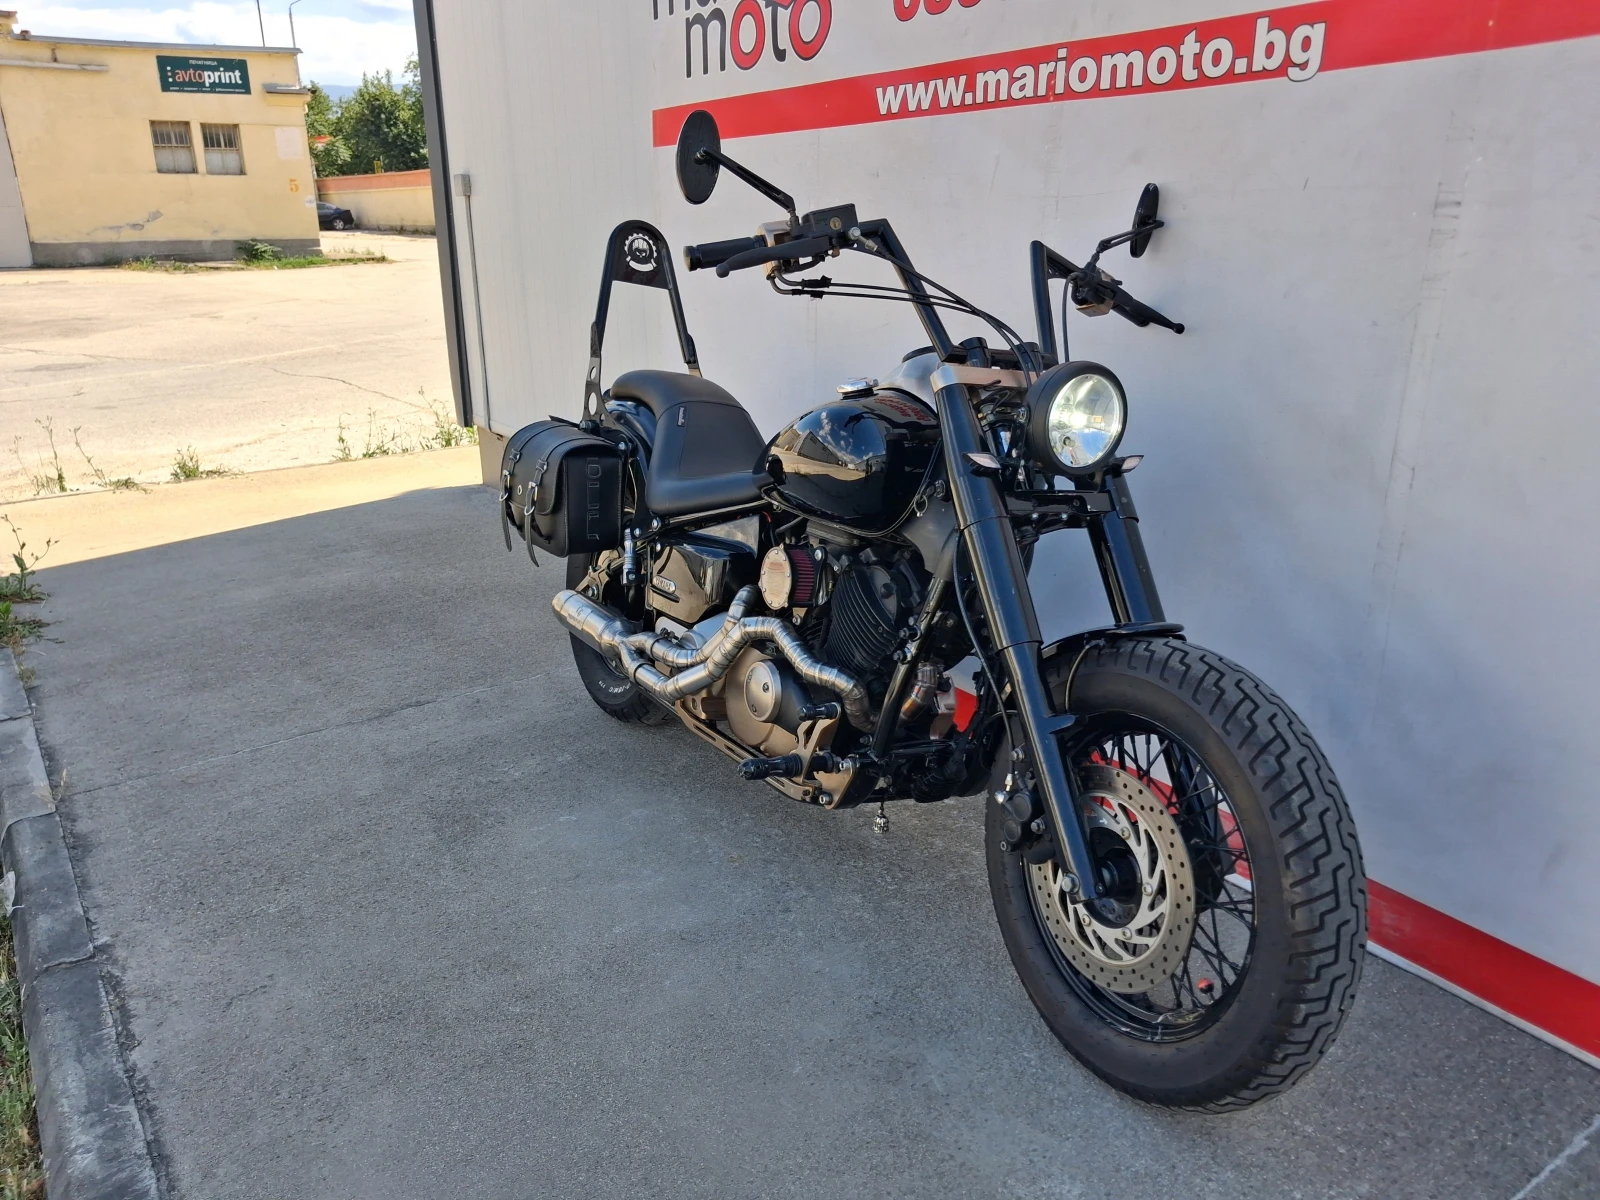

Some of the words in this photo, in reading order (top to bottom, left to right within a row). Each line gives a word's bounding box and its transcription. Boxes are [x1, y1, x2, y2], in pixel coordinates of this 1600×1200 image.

[685, 0, 833, 79] moto
[175, 67, 243, 87] avtoprint
[875, 17, 1326, 116] www.mariomoto.bg
[289, 178, 299, 193] 5
